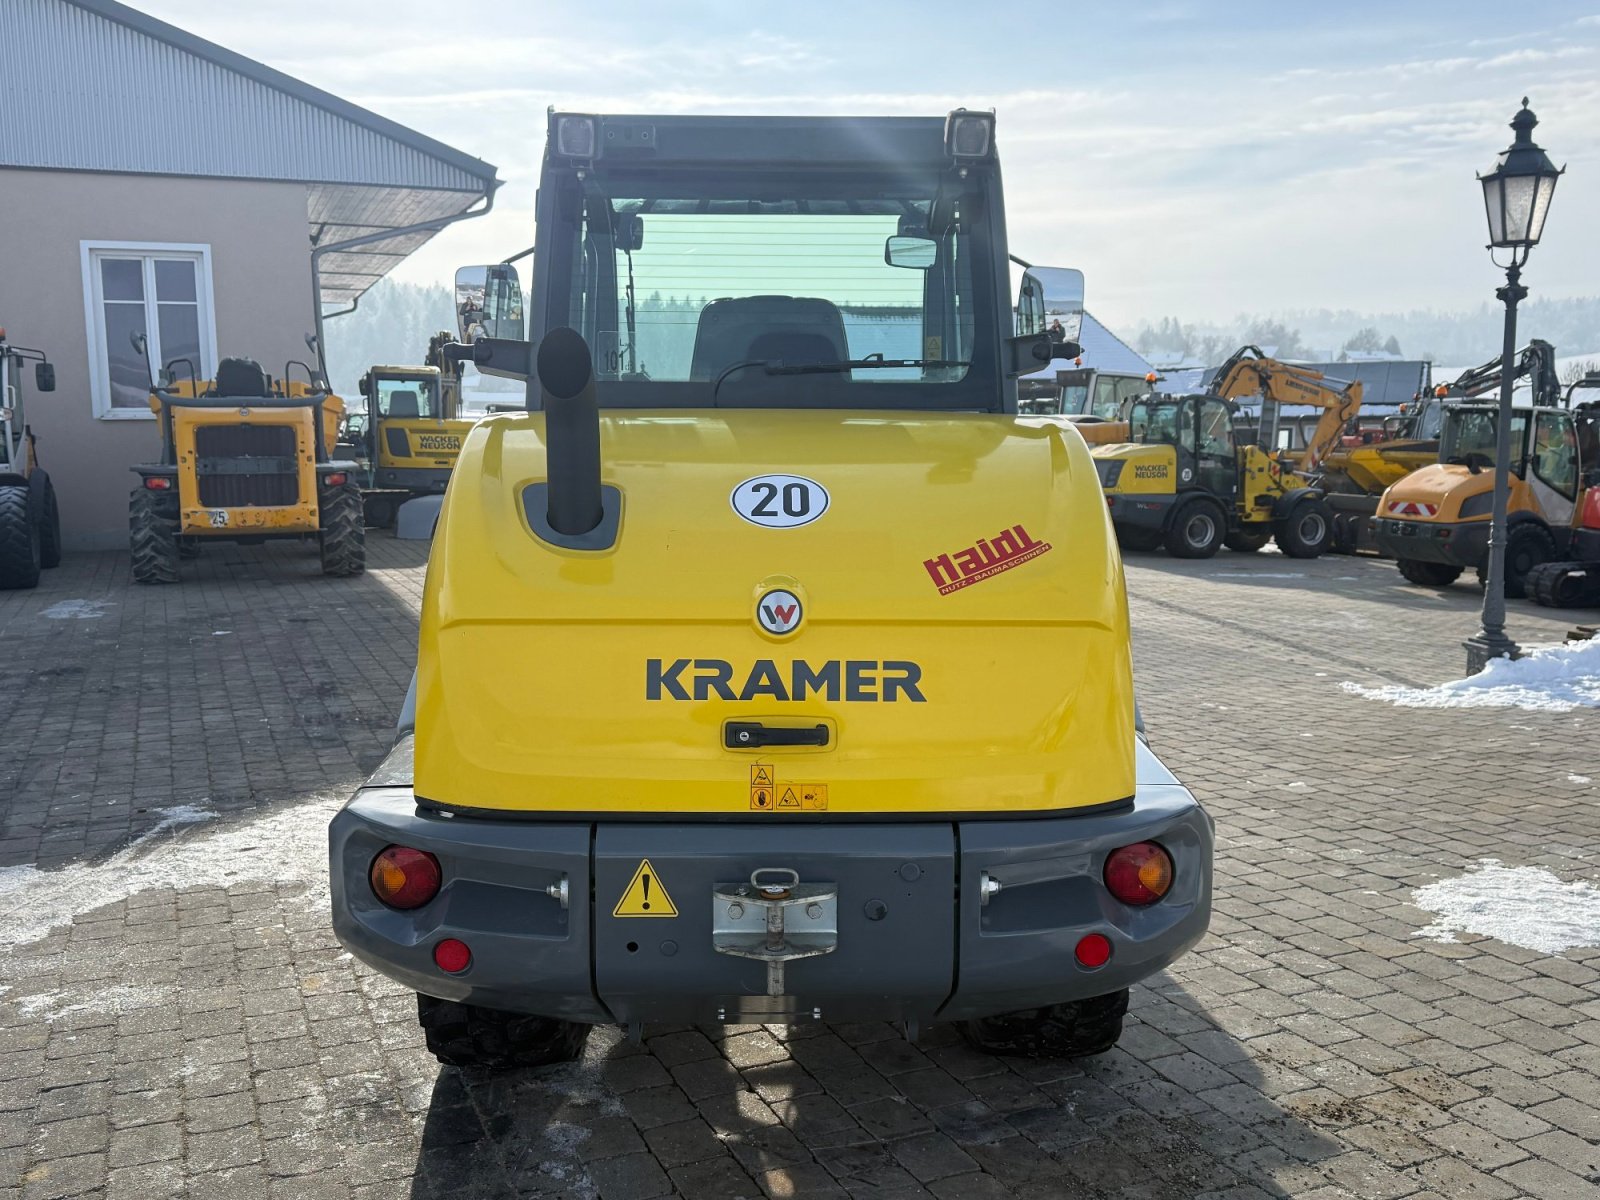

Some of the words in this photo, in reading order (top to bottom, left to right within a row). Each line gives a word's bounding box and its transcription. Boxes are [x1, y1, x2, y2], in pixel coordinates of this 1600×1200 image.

[604, 350, 624, 371] 101
[419, 435, 460, 443] WACKER
[420, 442, 461, 450] NEUSON
[1135, 471, 1168, 479] NEUSON
[751, 482, 810, 517] 20
[941, 579, 969, 595] NUTZ
[973, 543, 1051, 582] BAUMASCHINEN
[646, 658, 928, 703] KRAMER
